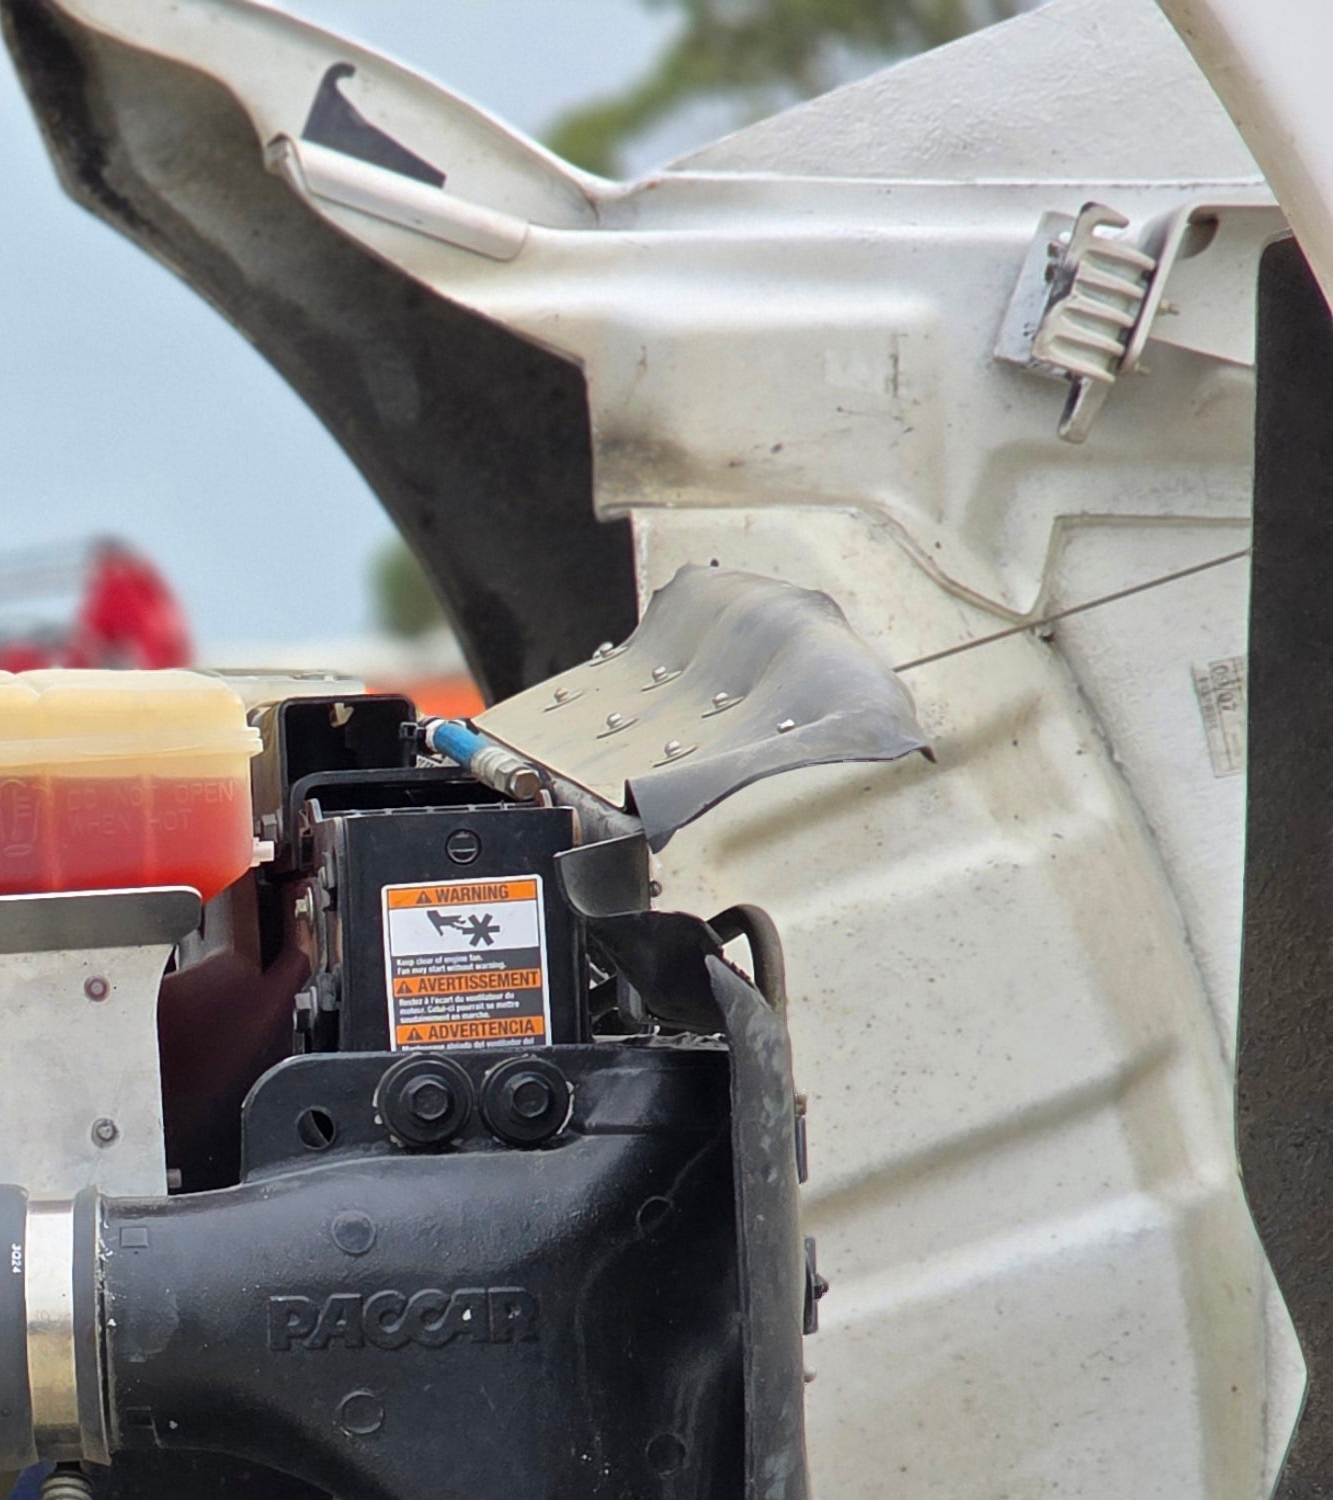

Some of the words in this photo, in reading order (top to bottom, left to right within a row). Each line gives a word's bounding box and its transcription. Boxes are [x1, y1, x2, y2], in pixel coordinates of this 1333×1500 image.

[175, 782, 234, 804] OPEN
[435, 885, 509, 903] WARNING
[418, 971, 537, 992] AVERTISSEMENT
[428, 1019, 535, 1040] ADVERTENCIA
[268, 1286, 540, 1351] PACCAR
